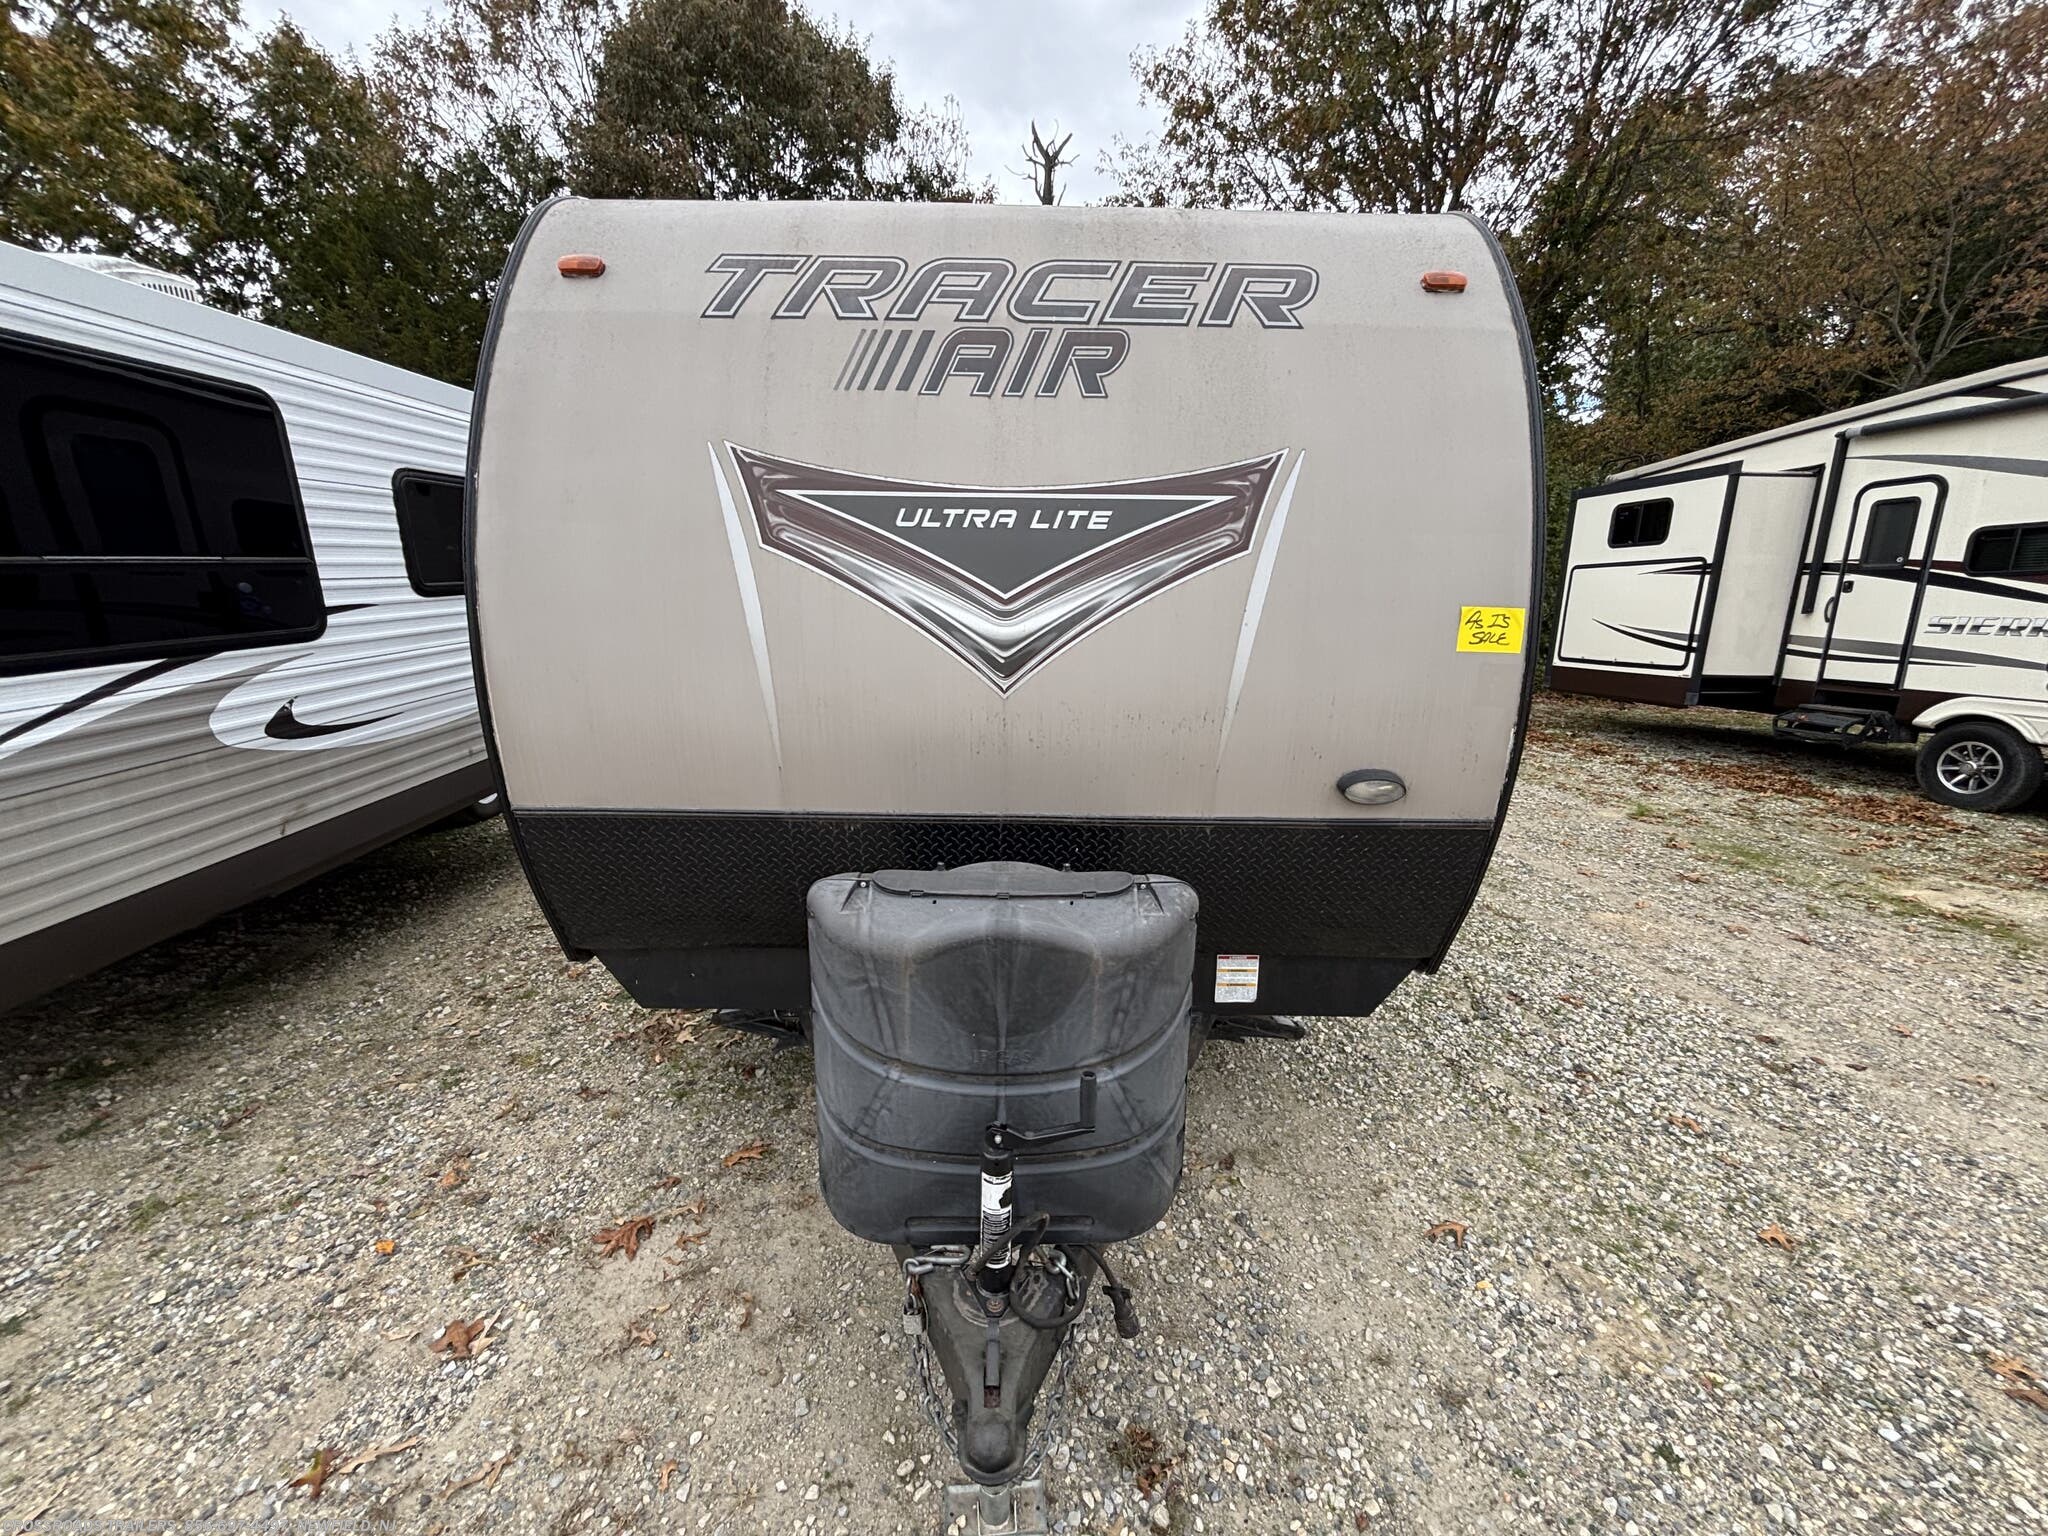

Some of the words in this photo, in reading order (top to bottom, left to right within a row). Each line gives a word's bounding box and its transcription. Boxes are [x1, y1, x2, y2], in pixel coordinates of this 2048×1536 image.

[701, 253, 1320, 329] TRACER
[919, 327, 1130, 398] AIR
[895, 508, 1017, 529] ULTRA
[1029, 510, 1113, 529] LITE
[1487, 613, 1511, 629] IS
